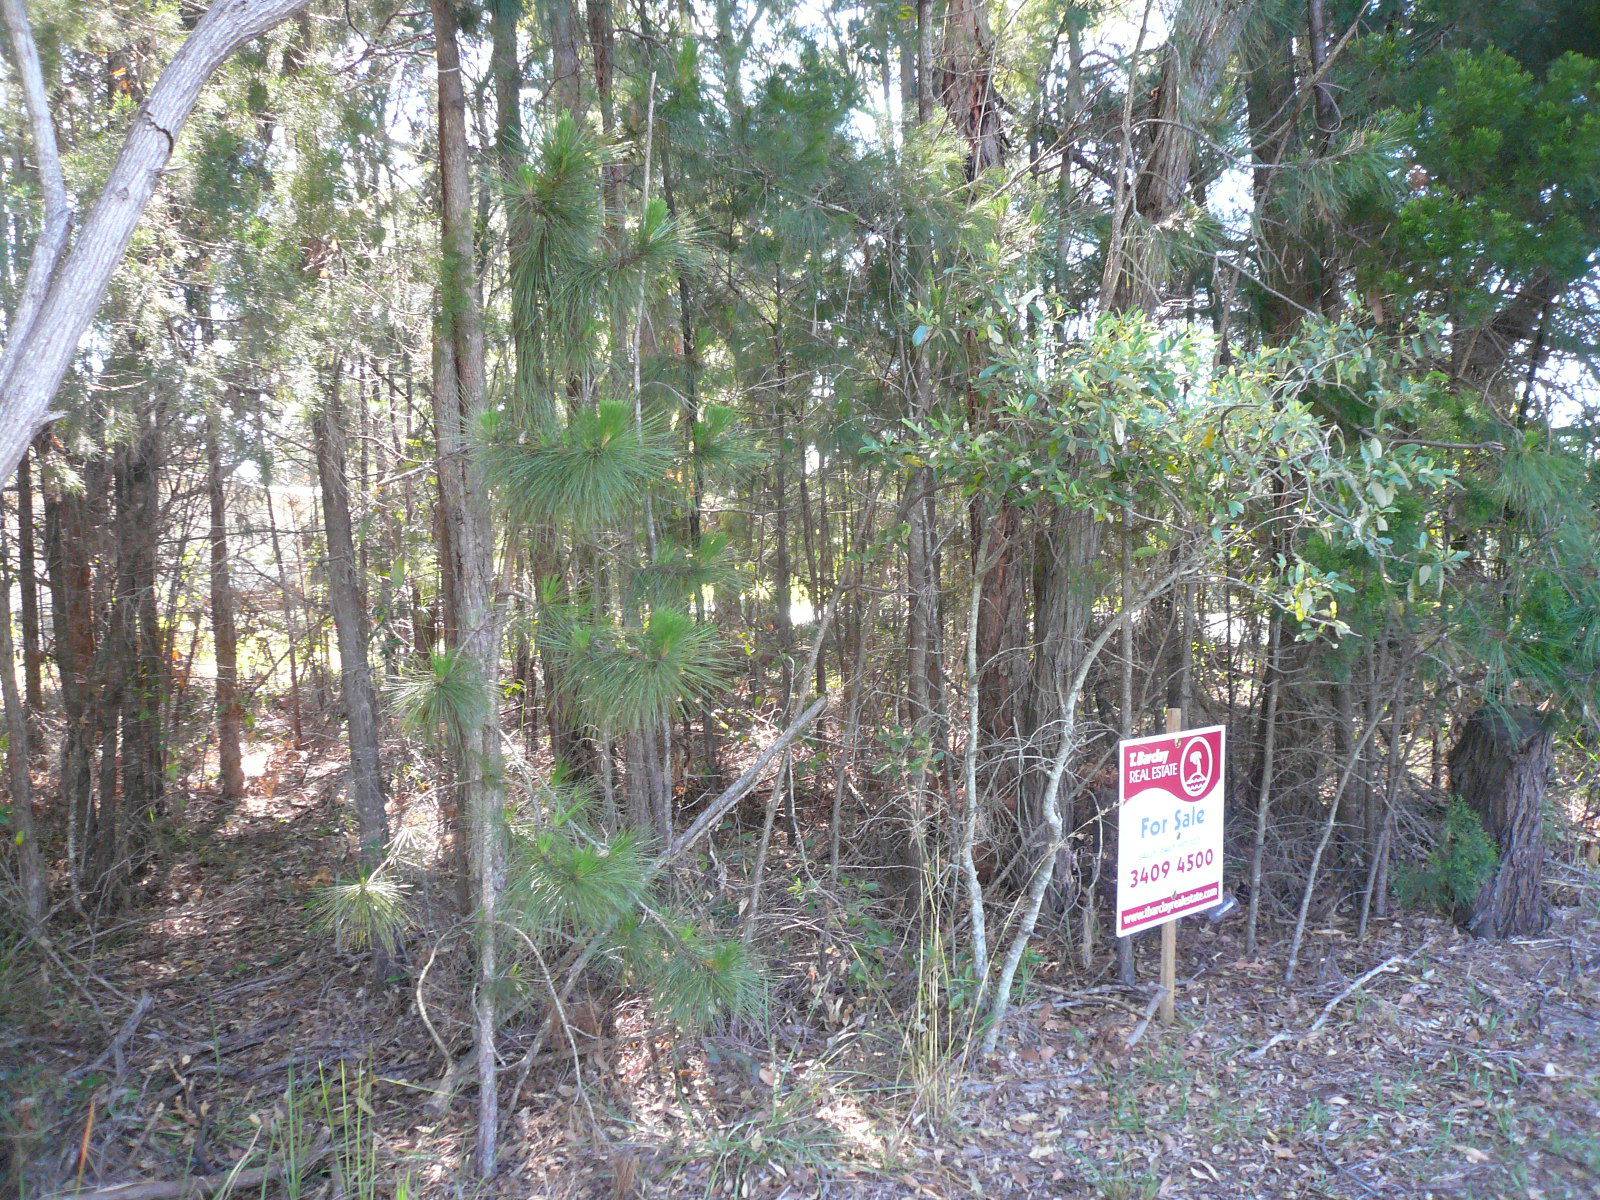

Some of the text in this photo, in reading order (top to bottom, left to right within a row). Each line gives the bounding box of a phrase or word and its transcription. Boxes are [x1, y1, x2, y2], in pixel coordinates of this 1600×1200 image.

[1129, 762, 1178, 783] REAL ESTATE
[1141, 806, 1205, 838] For Sale
[1130, 849, 1213, 888] 3409 4500
